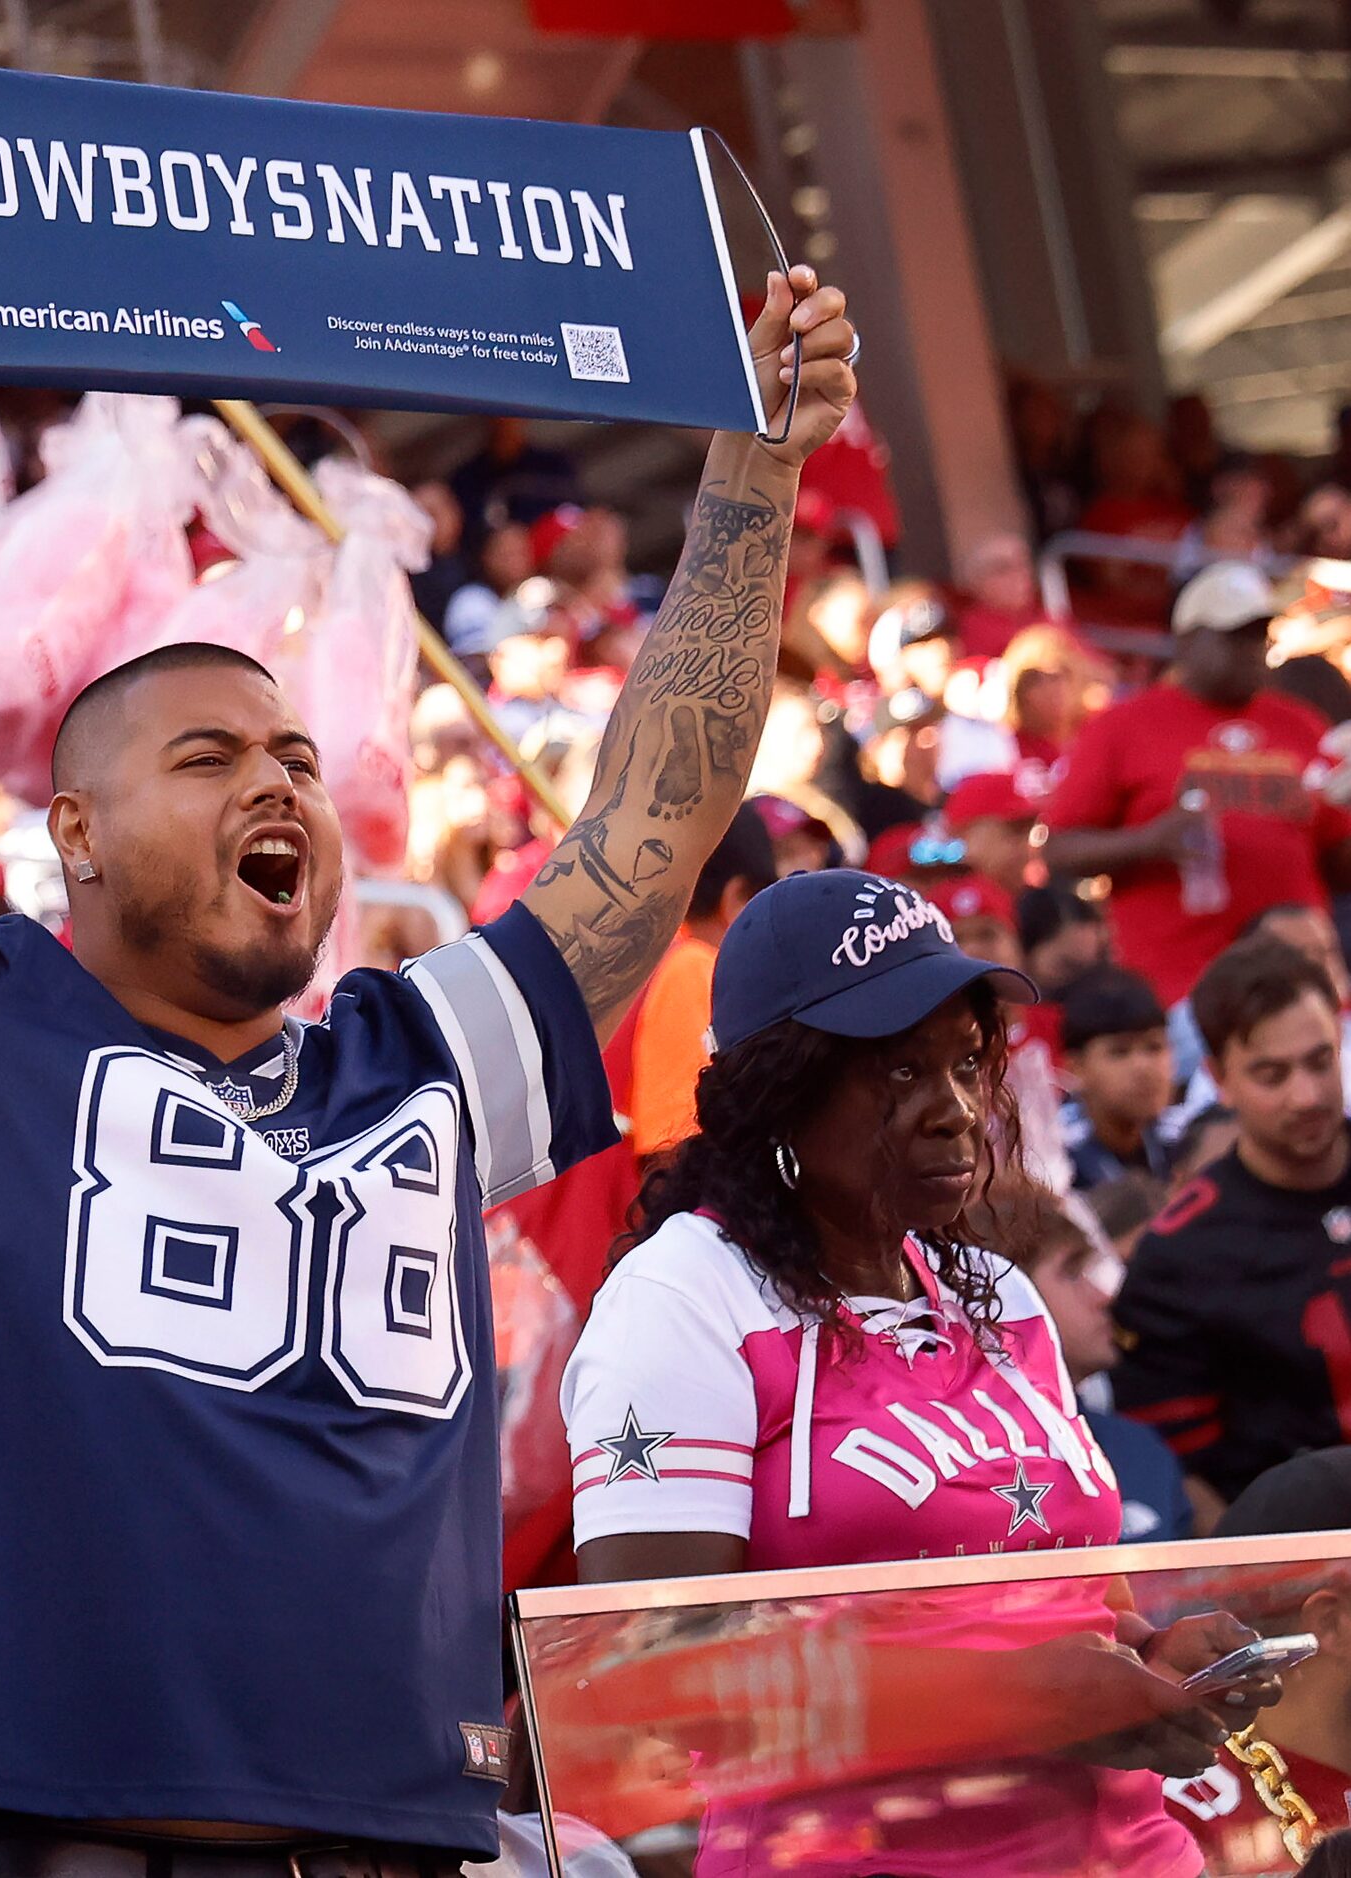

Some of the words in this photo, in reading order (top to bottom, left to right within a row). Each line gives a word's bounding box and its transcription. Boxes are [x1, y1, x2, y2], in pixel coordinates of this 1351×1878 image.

[113, 307, 225, 340] Airlines
[327, 316, 383, 333] Discover
[386, 322, 435, 338] endless
[437, 328, 470, 343] ways
[472, 329, 486, 342] to
[488, 332, 518, 345] earn
[520, 333, 555, 347] miles
[354, 336, 381, 351] Join
[472, 344, 491, 360] for
[493, 346, 519, 361] free
[521, 350, 558, 367] today
[832, 894, 955, 967] Cowboy
[63, 1045, 473, 1420] 88
